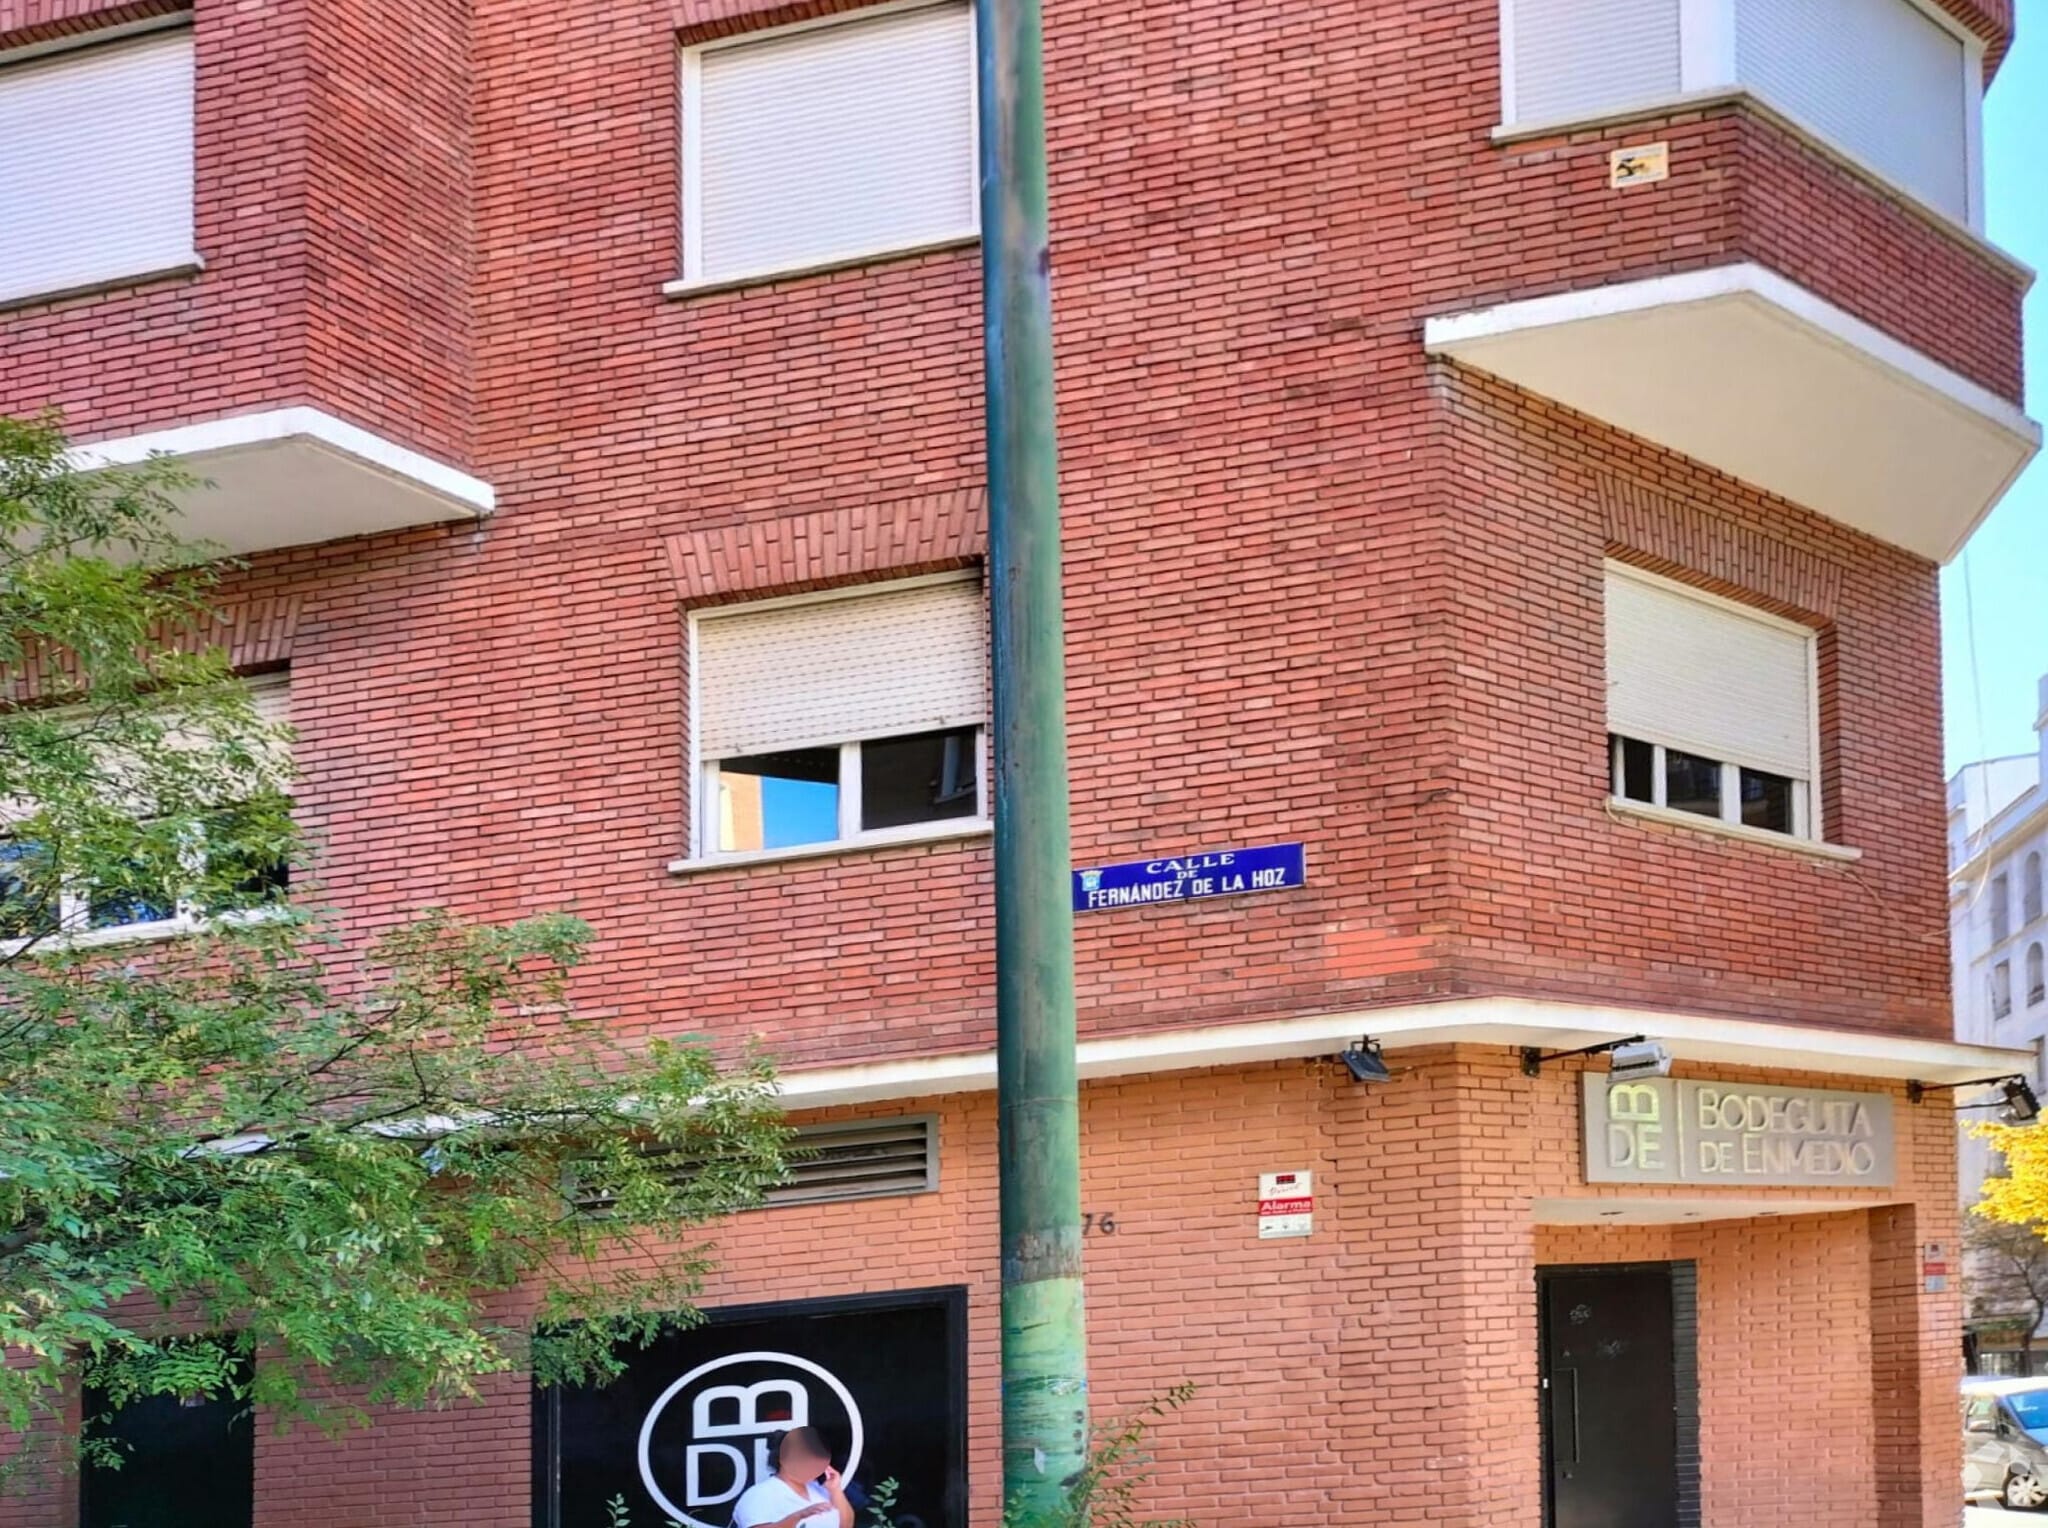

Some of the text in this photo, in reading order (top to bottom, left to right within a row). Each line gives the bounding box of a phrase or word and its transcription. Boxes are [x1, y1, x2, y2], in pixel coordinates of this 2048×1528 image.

[1146, 852, 1236, 875] CALLE
[1176, 869, 1199, 881] DE
[1088, 867, 1286, 908] FERNÁNDEZ DE LA HOZ
[1697, 1087, 1873, 1138] BODEGUITA
[1608, 1122, 1665, 1170] DE
[1699, 1141, 1735, 1174] DE
[1080, 1211, 1115, 1236] 76
